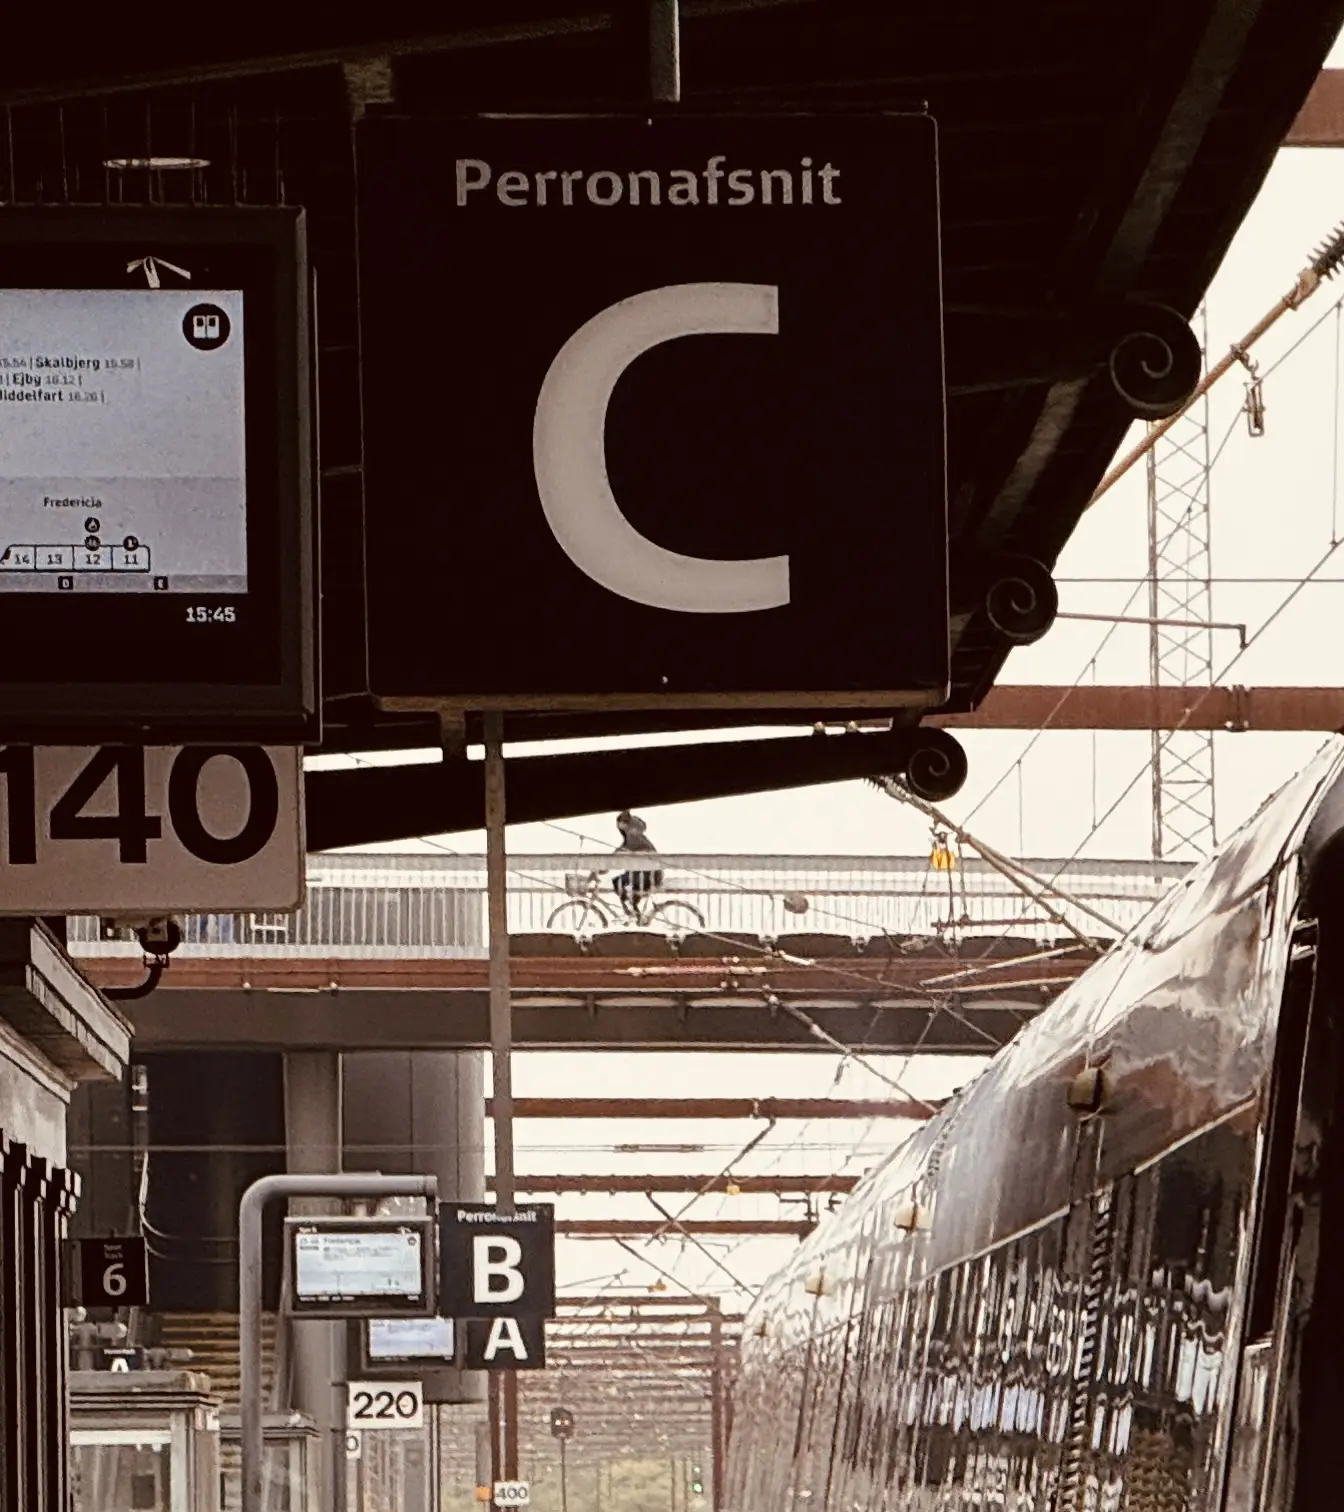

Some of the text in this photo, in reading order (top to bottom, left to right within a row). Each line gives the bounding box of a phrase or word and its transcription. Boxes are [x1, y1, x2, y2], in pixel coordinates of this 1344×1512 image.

[454, 155, 842, 207] Perronafsnit
[35, 355, 101, 371] Skalbjerg
[12, 373, 42, 387] Ejby
[0, 389, 63, 401] iddelfart
[532, 281, 791, 614] C
[43, 497, 102, 508] Fredericia
[85, 554, 101, 565] 12
[124, 554, 138, 565] 11
[185, 606, 237, 622] 15:45
[0, 745, 280, 866] 140
[102, 1262, 127, 1296] 6
[473, 1234, 525, 1304] B
[483, 1316, 528, 1361] A
[352, 1390, 419, 1419] 220
